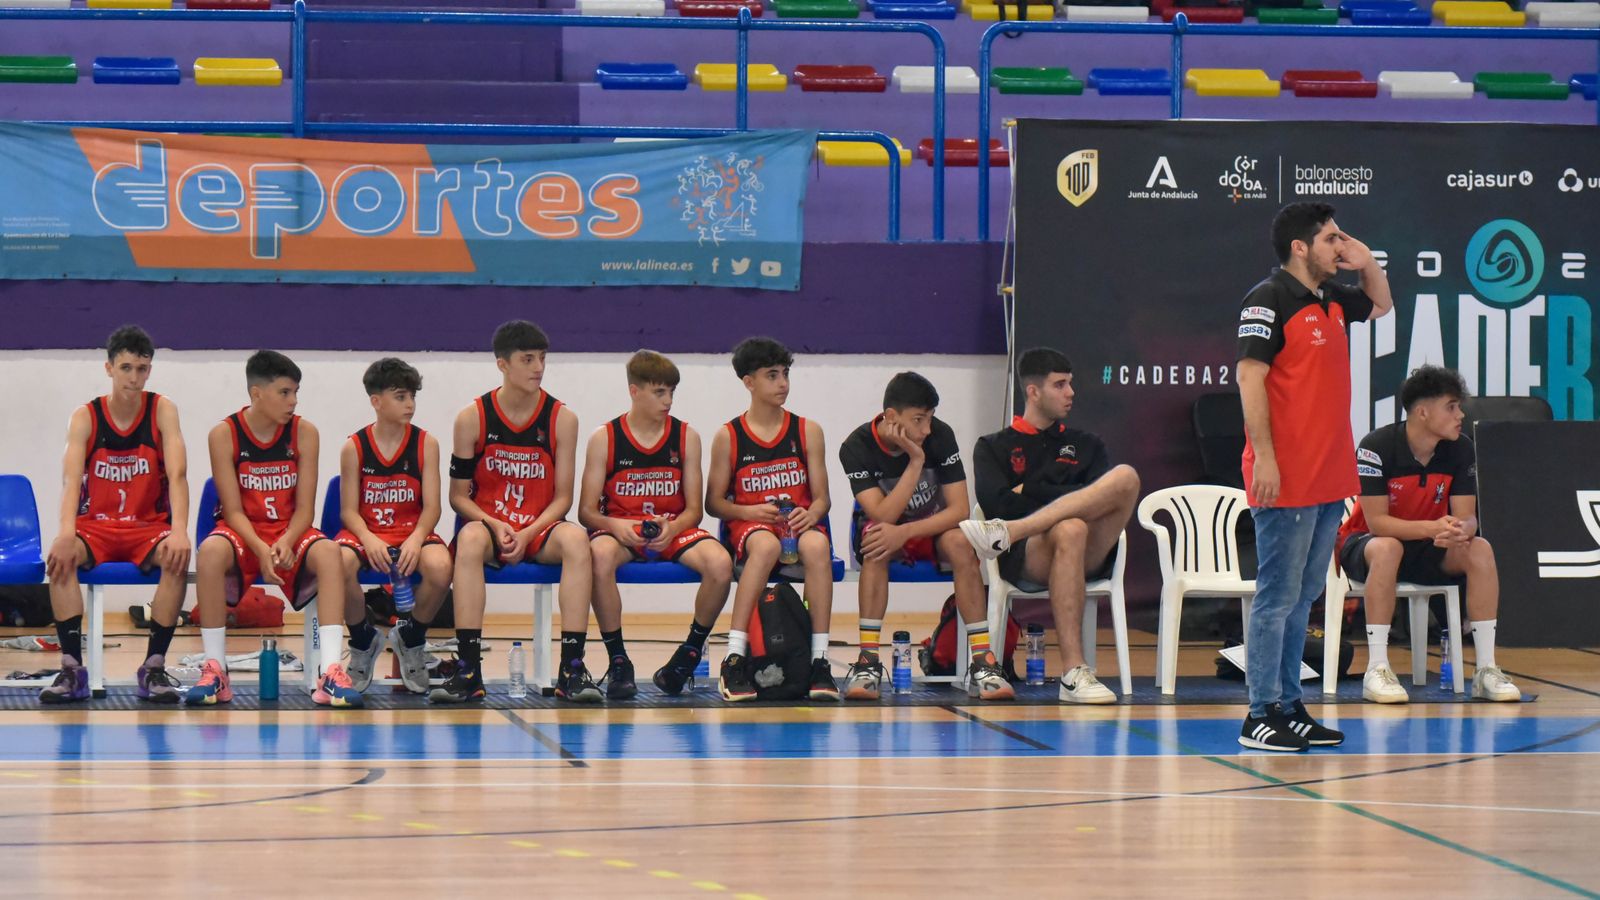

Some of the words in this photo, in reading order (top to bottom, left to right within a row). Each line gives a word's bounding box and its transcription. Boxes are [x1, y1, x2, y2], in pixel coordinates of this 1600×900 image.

[1295, 164, 1373, 180] baloncesto
[1447, 170, 1517, 191] cajasur
[92, 138, 643, 260] deportes
[1127, 190, 1150, 199] Junta
[1150, 190, 1160, 199] de
[601, 259, 694, 271] www.lalinea.es
[95, 457, 150, 482] GANA
[485, 456, 545, 479] GRANADA
[627, 472, 664, 481] FUNDACION
[665, 471, 673, 479] CB
[751, 463, 787, 476] FUNDACION
[788, 461, 798, 469] CB
[240, 472, 298, 492] GRANADA
[367, 480, 398, 490] FUNDAON
[741, 469, 807, 492] GRANADA
[364, 488, 415, 504] RANADA
[504, 481, 524, 509] 14
[264, 496, 279, 520] 5
